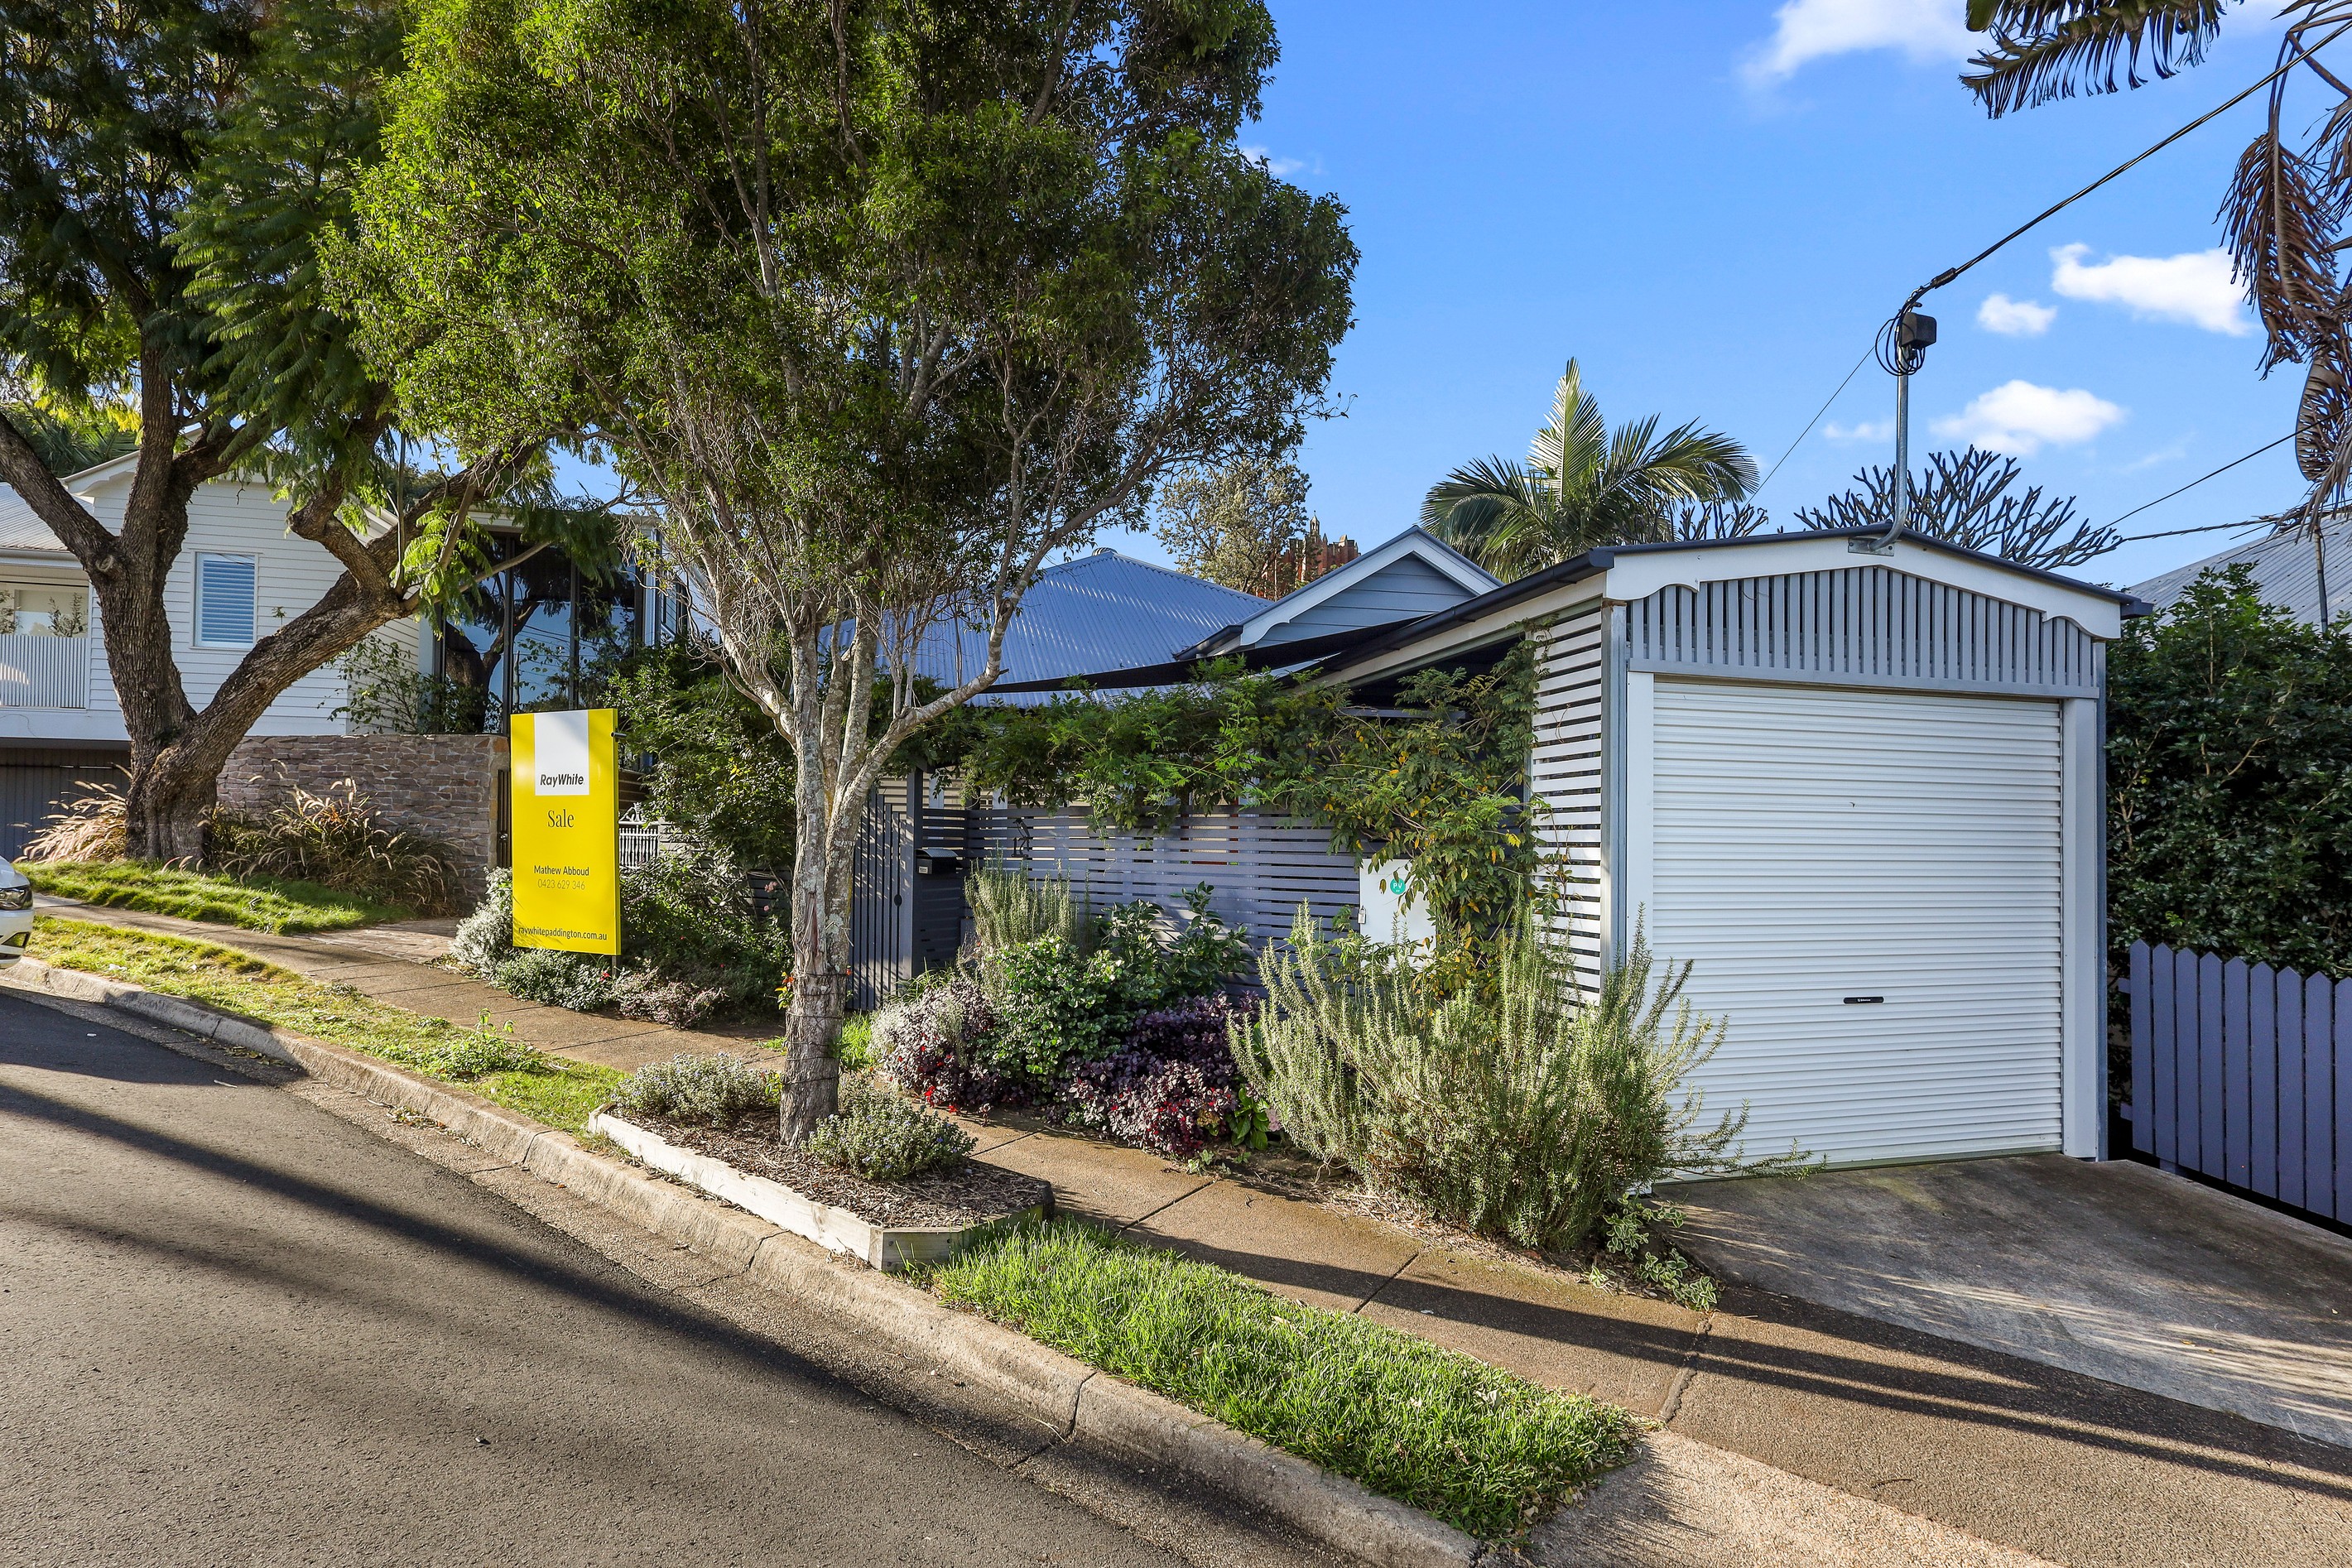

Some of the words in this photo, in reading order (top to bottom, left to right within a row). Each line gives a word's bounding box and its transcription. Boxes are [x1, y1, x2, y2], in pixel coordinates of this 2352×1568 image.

[540, 774, 584, 787] RayWhite
[547, 809, 575, 828] Sale
[534, 865, 561, 875] Mathew
[563, 867, 589, 876] Abboud
[537, 878, 556, 888] 0423
[557, 880, 570, 889] 629
[572, 881, 585, 890] 346
[518, 926, 608, 940] raywhitepaddington.com.au
